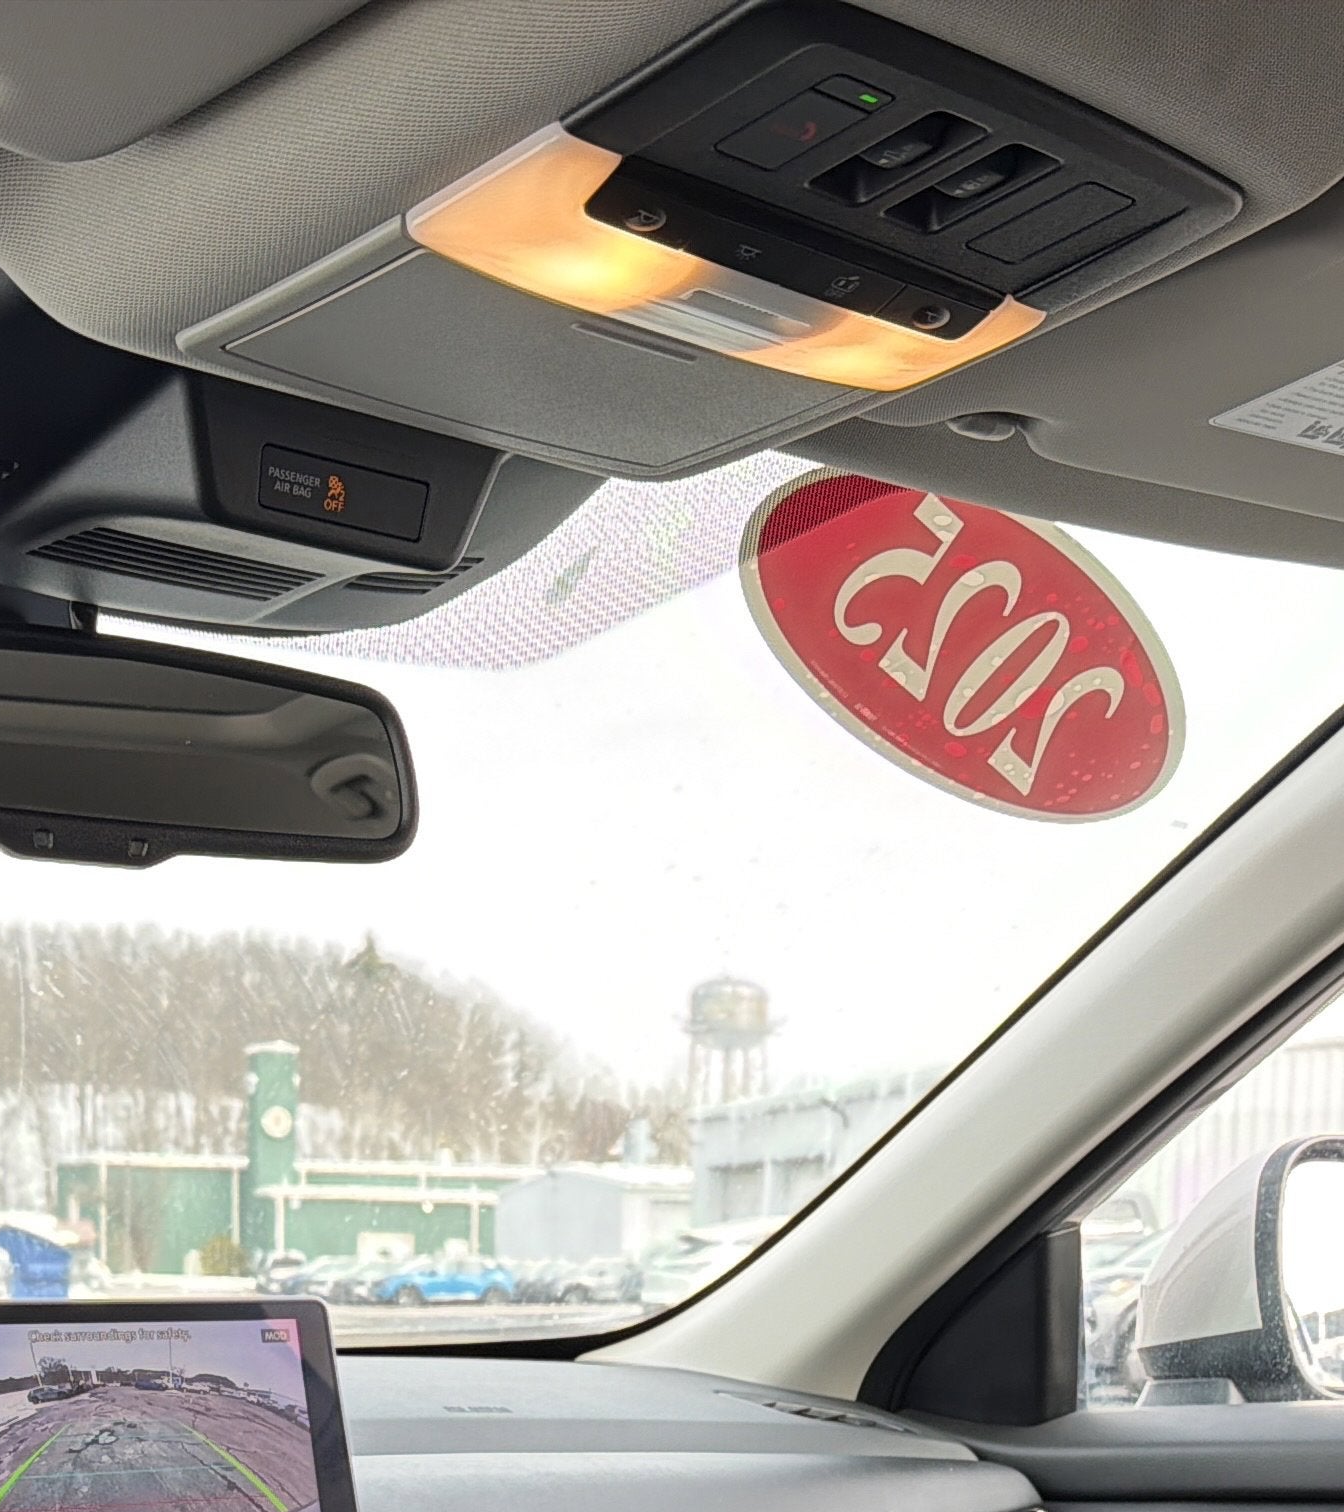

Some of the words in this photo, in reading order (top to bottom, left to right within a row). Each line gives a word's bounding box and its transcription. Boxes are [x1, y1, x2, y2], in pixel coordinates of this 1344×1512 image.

[268, 466, 321, 488] PASSENGER
[273, 480, 291, 494] AIR
[292, 485, 313, 499] BAG
[323, 499, 346, 513] OFF
[27, 1328, 64, 1343] Check
[137, 1327, 156, 1341] for
[263, 1331, 289, 1342] MOD
